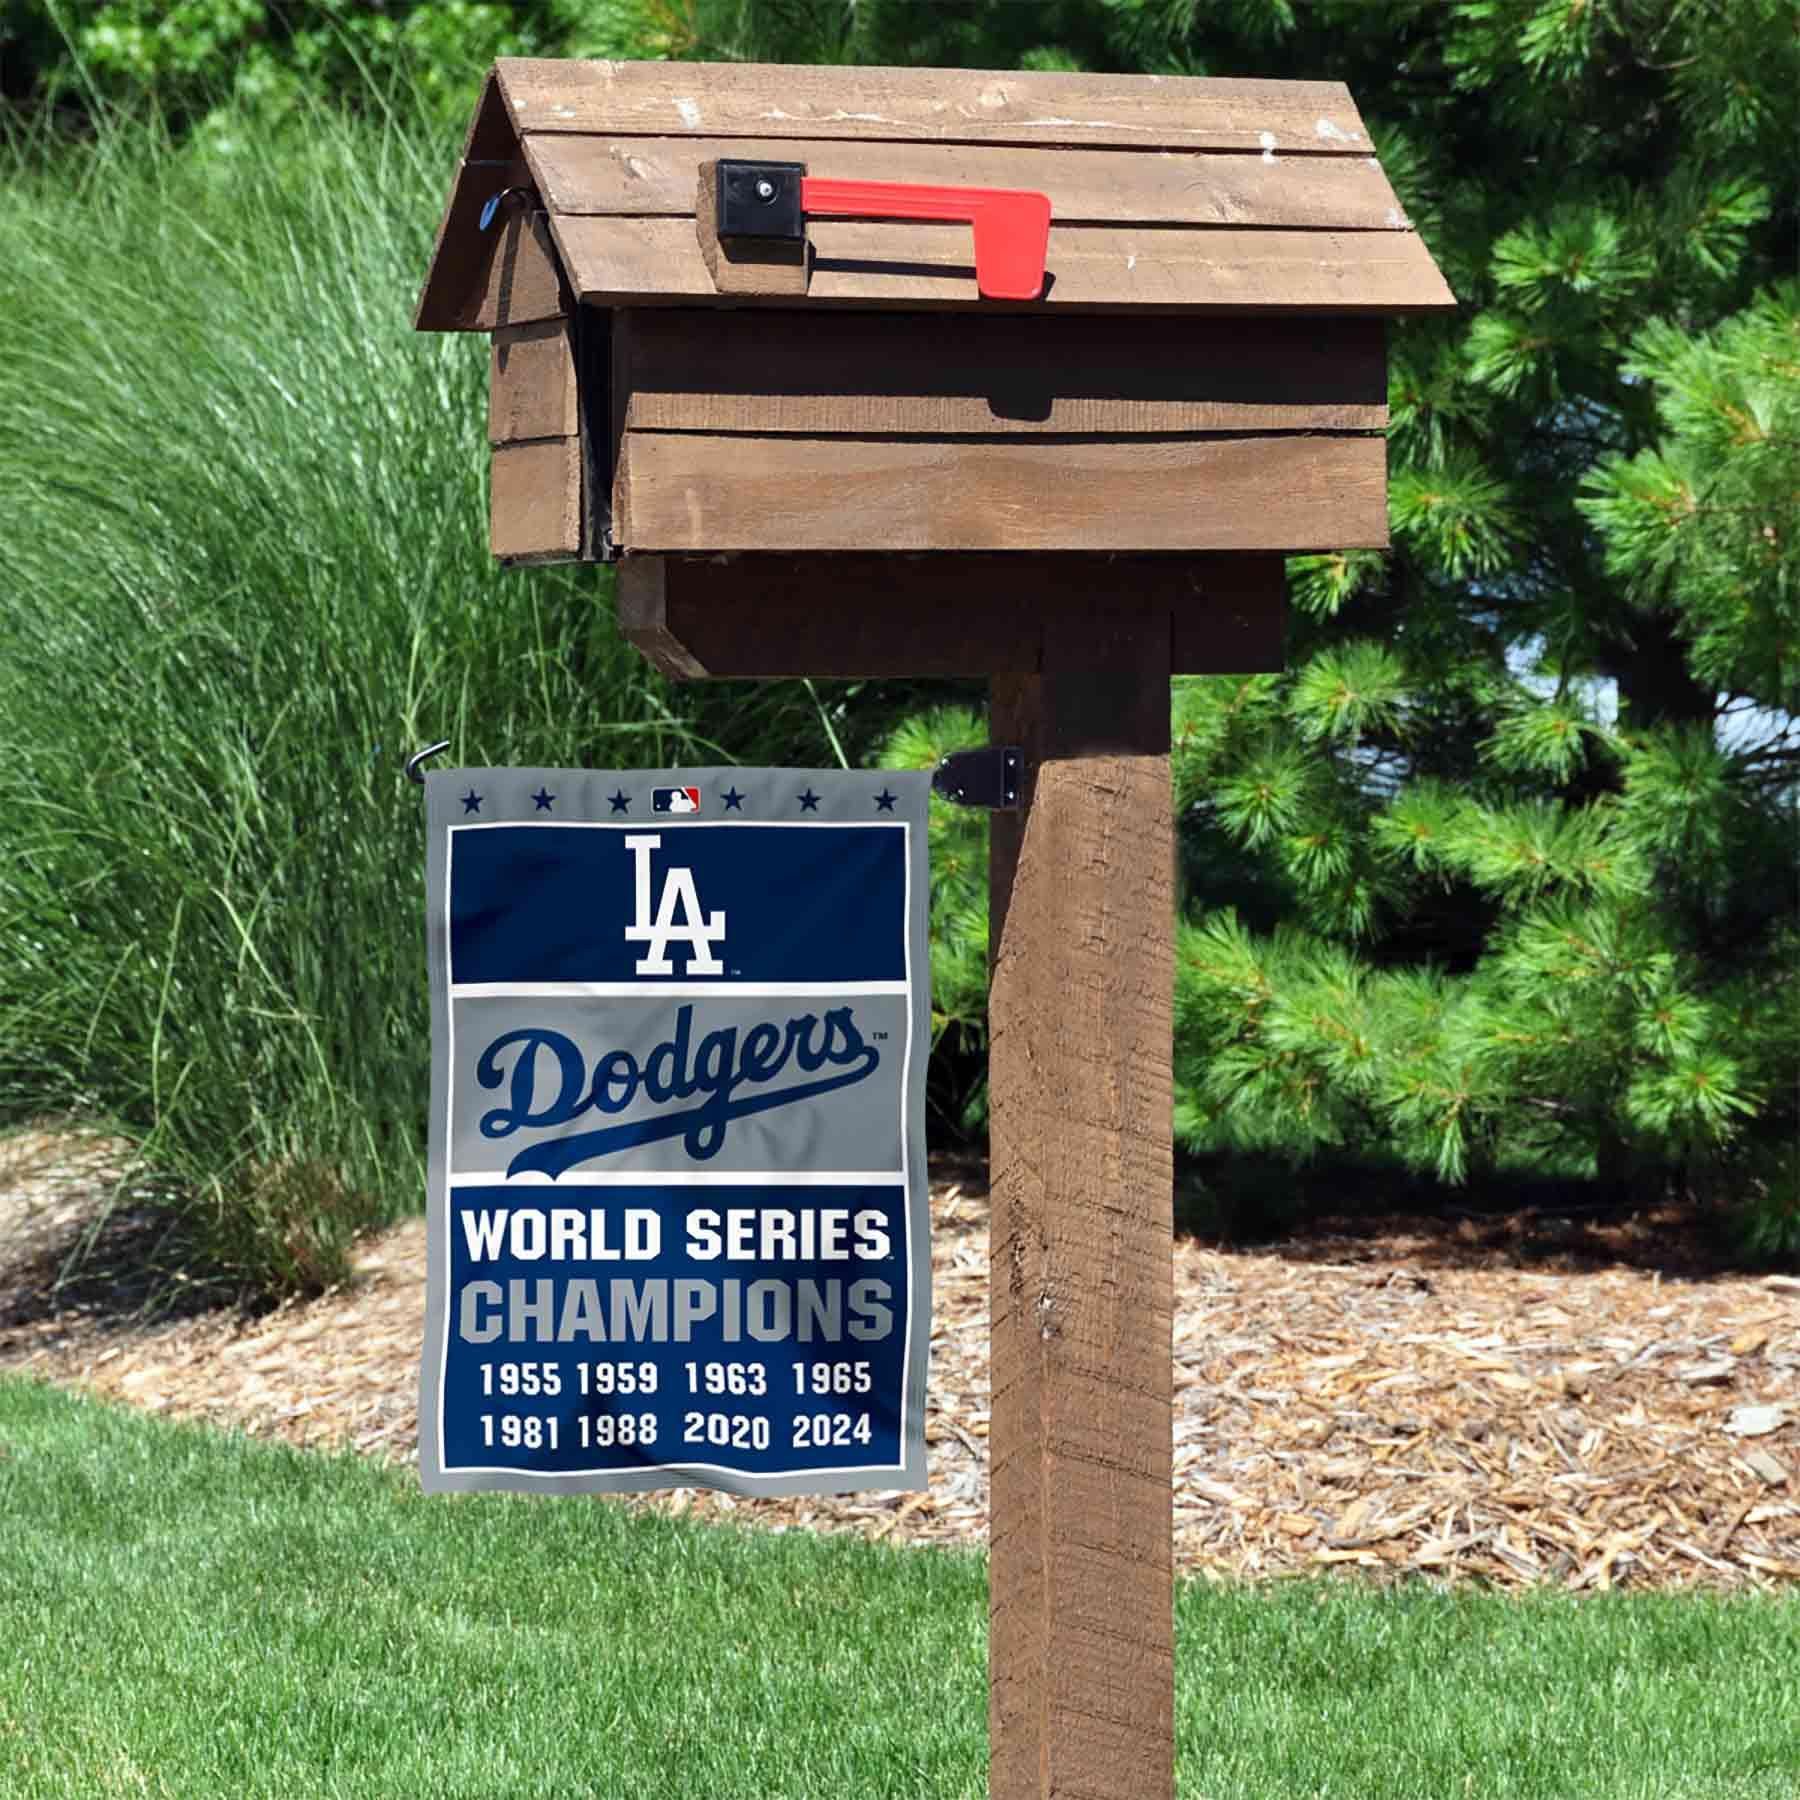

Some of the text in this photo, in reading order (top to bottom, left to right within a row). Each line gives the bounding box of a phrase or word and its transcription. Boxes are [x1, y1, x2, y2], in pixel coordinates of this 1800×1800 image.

[625, 835, 725, 975] LA
[477, 1004, 880, 1162] Dodgers
[461, 1209, 889, 1261] WORLD SERIES
[460, 1279, 892, 1343] CHAMPIONS
[480, 1362, 871, 1395] 1955 1959 1963 1965
[481, 1412, 872, 1449] 1981 1988 2020 2024
